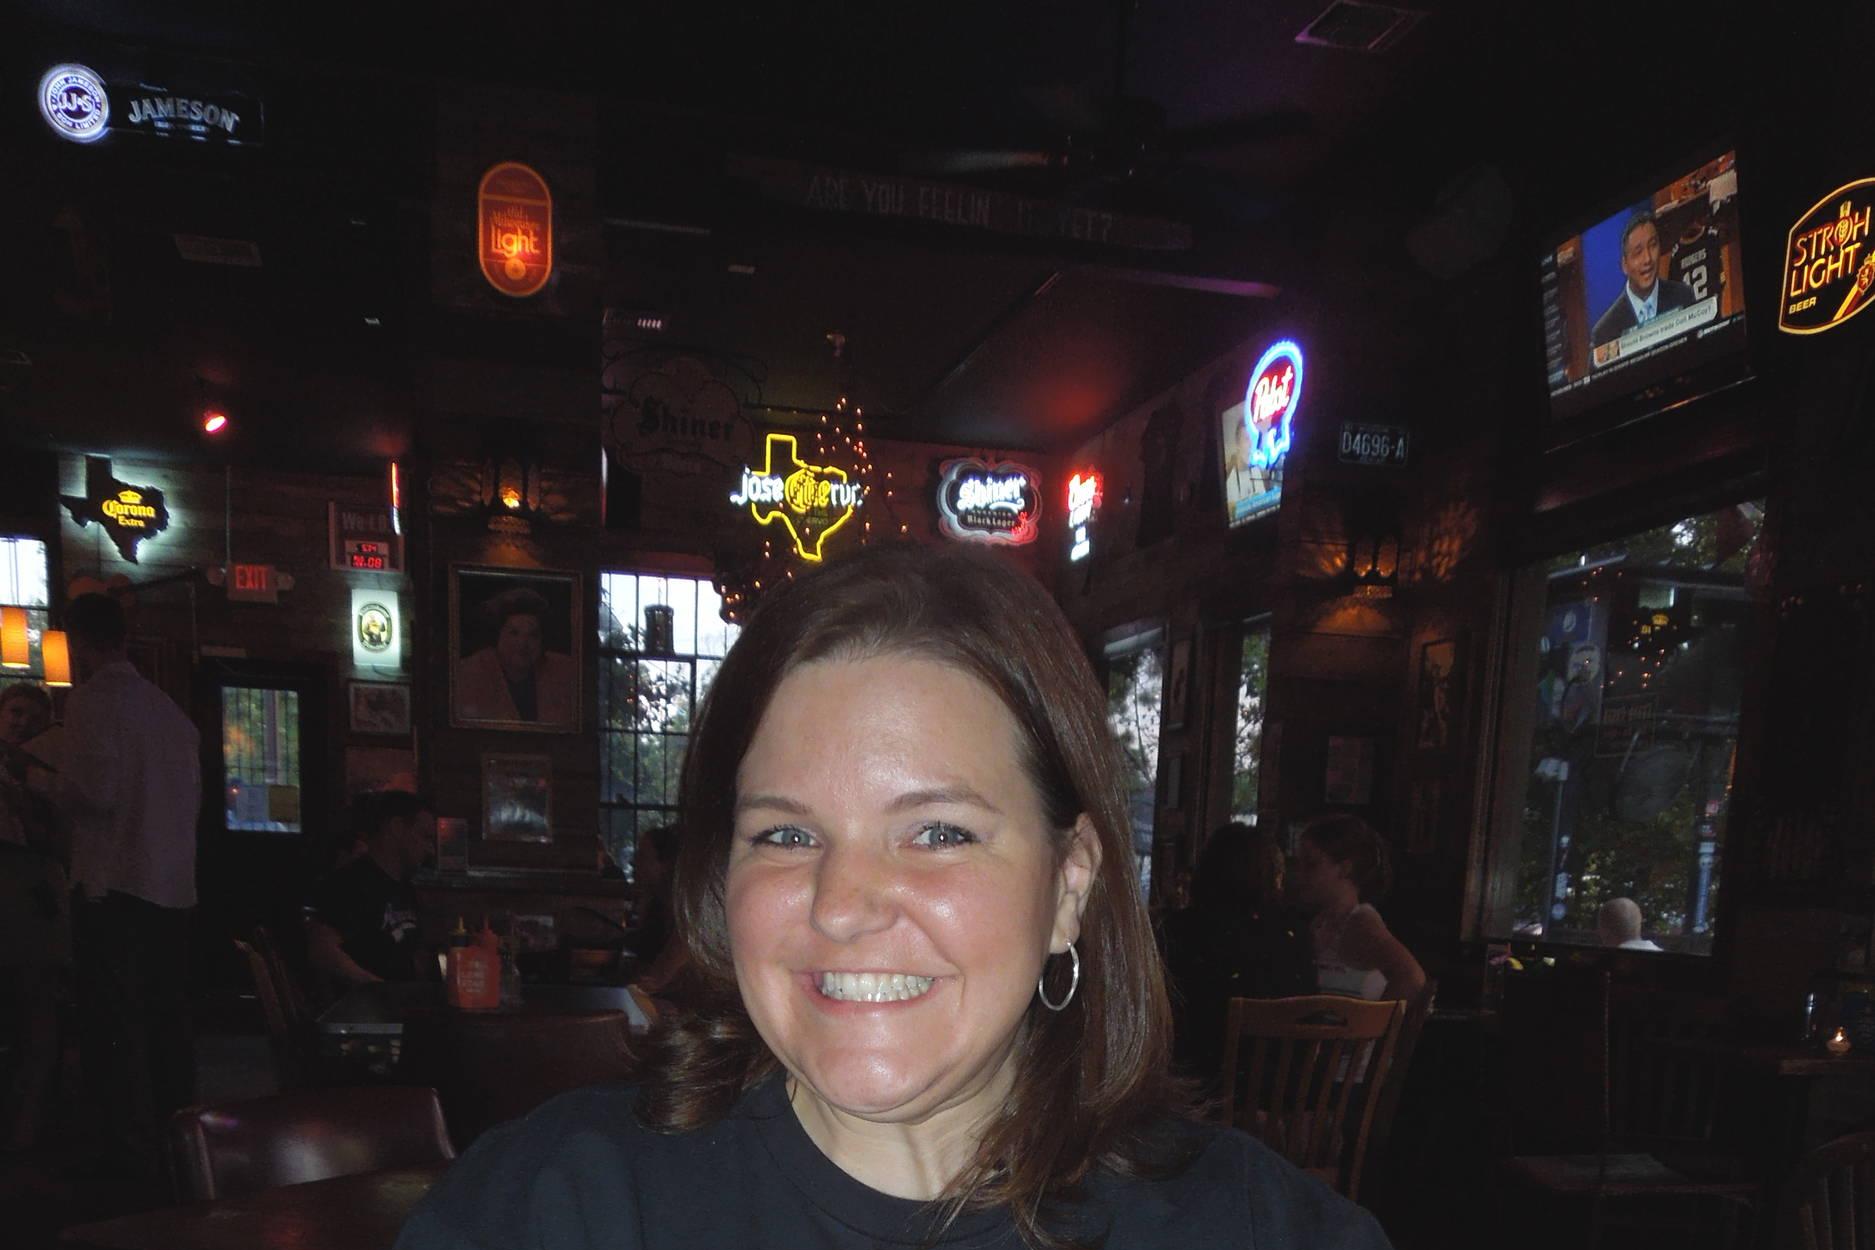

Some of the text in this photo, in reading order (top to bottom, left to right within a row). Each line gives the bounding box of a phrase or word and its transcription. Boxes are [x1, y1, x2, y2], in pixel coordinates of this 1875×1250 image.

[128, 98, 240, 133] JAMESON
[491, 222, 540, 258] Light
[1790, 242, 1862, 297] LIGHT
[1789, 297, 1817, 314] BEER
[1342, 431, 1405, 460] D4696-A
[102, 500, 156, 518] Corona
[118, 516, 145, 527] Extra
[236, 565, 267, 591] EXIT
